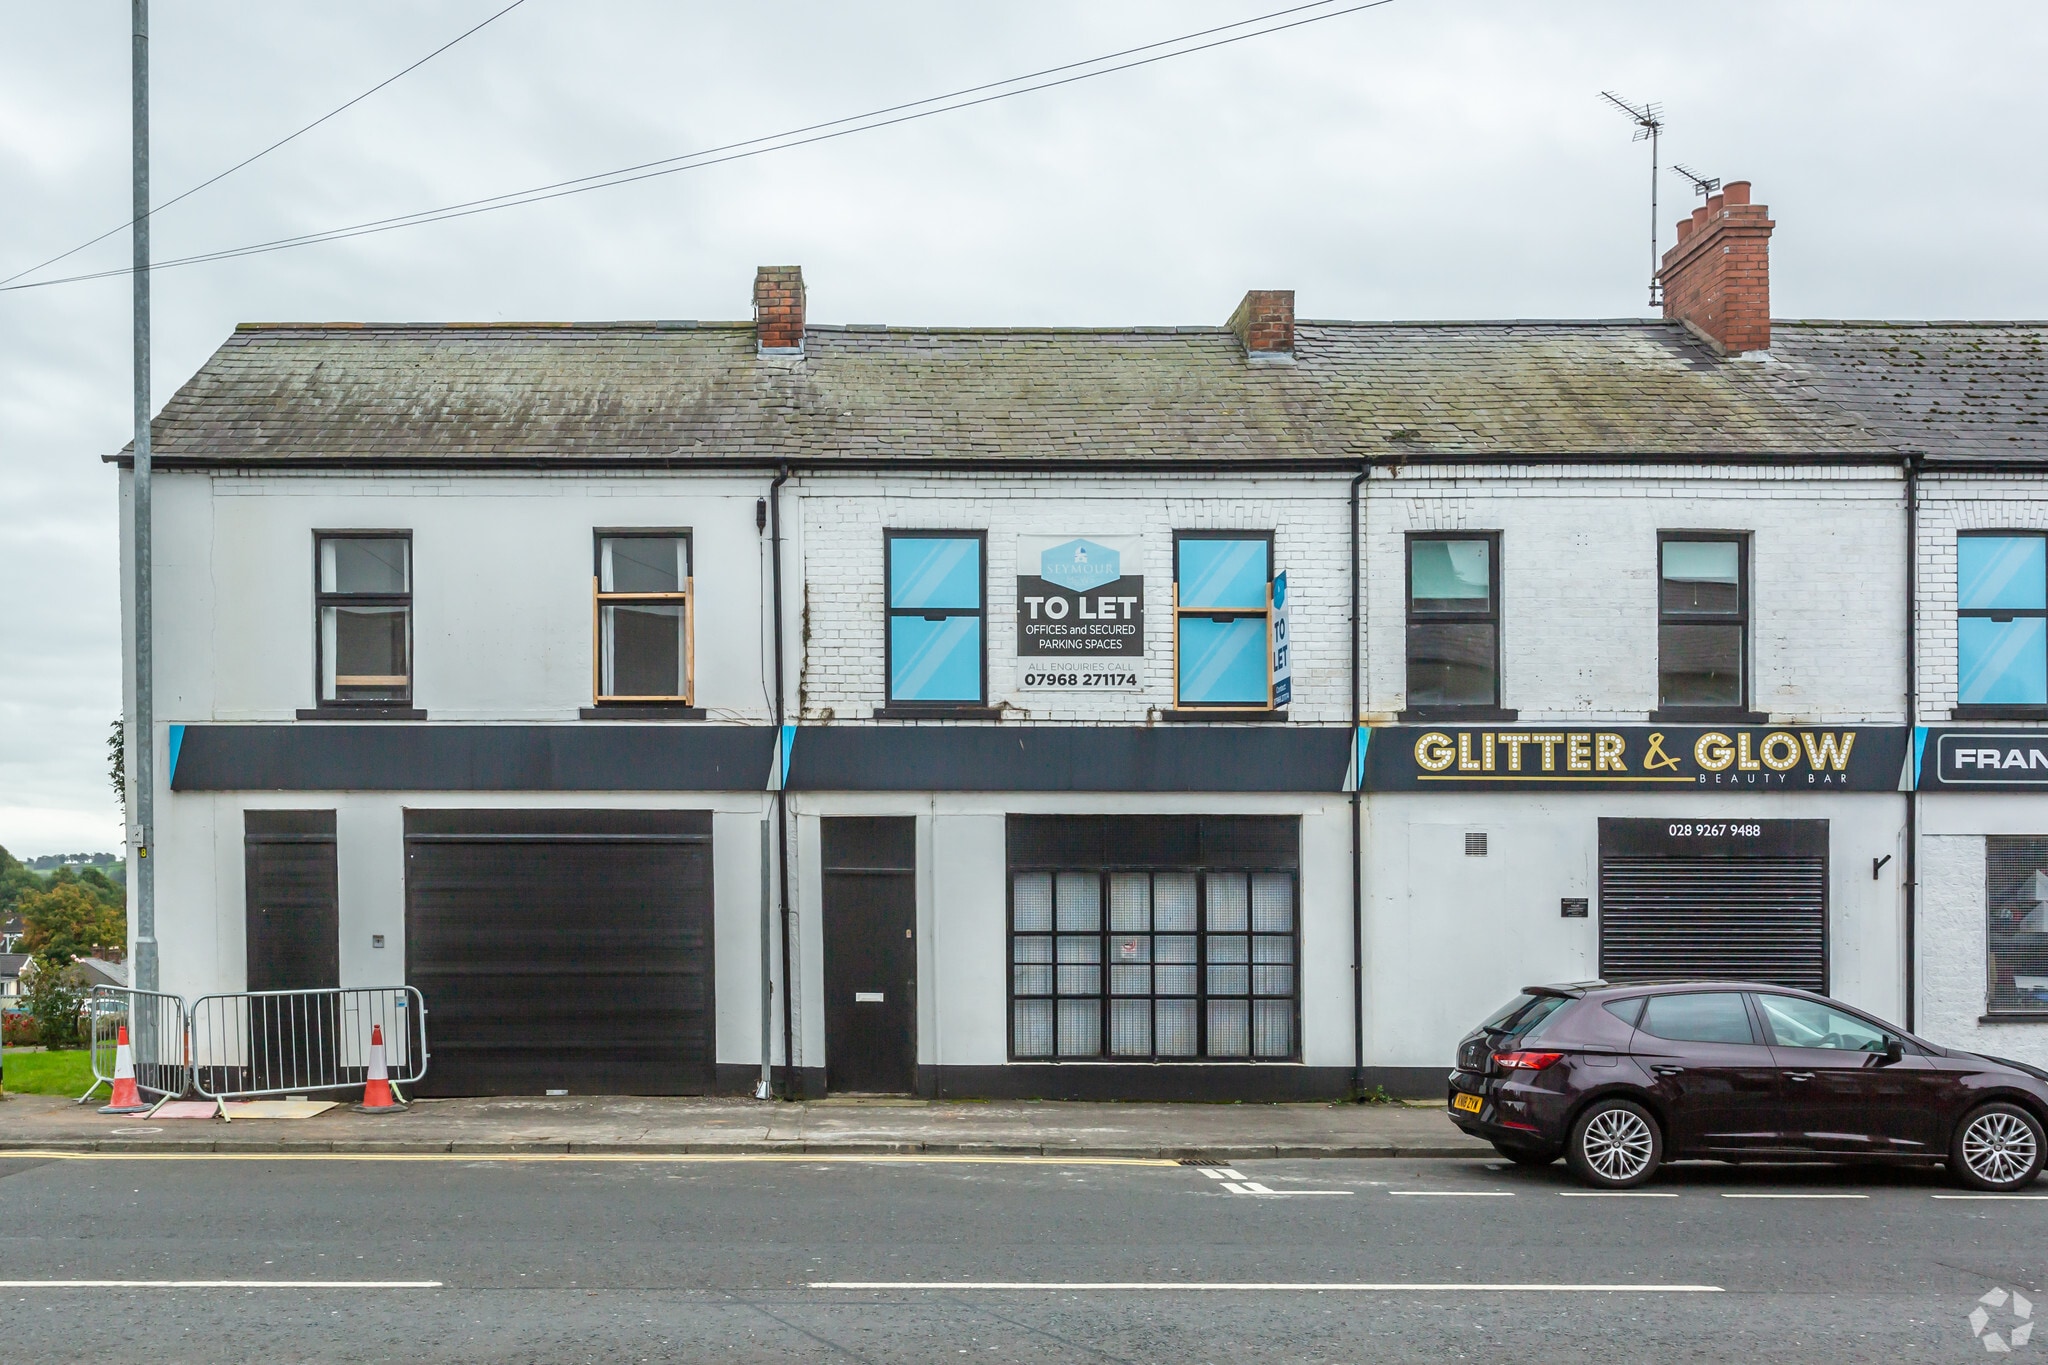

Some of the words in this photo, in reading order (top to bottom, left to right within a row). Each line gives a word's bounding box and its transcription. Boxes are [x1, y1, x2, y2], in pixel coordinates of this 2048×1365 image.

[1047, 563, 1114, 574] SEYMOUR
[1024, 596, 1069, 620] TO
[1079, 596, 1138, 620] LET
[1025, 624, 1067, 635] OFFICES
[1069, 624, 1087, 635] and
[1089, 624, 1136, 635] SECURED
[1274, 617, 1286, 643] TO
[1039, 639, 1083, 649] PARKING
[1084, 639, 1123, 649] SPACES
[1273, 644, 1288, 673] LET
[1028, 662, 1047, 671] ALL
[1050, 662, 1105, 671] ENQUIRIES
[1107, 662, 1134, 671] CALL
[1024, 673, 1078, 686] 07968
[1082, 673, 1138, 686] 271174
[1414, 732, 1628, 772] GLITTER
[1643, 732, 1681, 772] &
[1694, 731, 1857, 772] GLOW
[1699, 773, 1787, 784] BEAUTY
[1808, 773, 1848, 784] BAR
[1668, 824, 1693, 837] 028
[1695, 824, 1727, 837] 9267
[1730, 824, 1761, 837] 9488
[141, 848, 147, 858] 8
